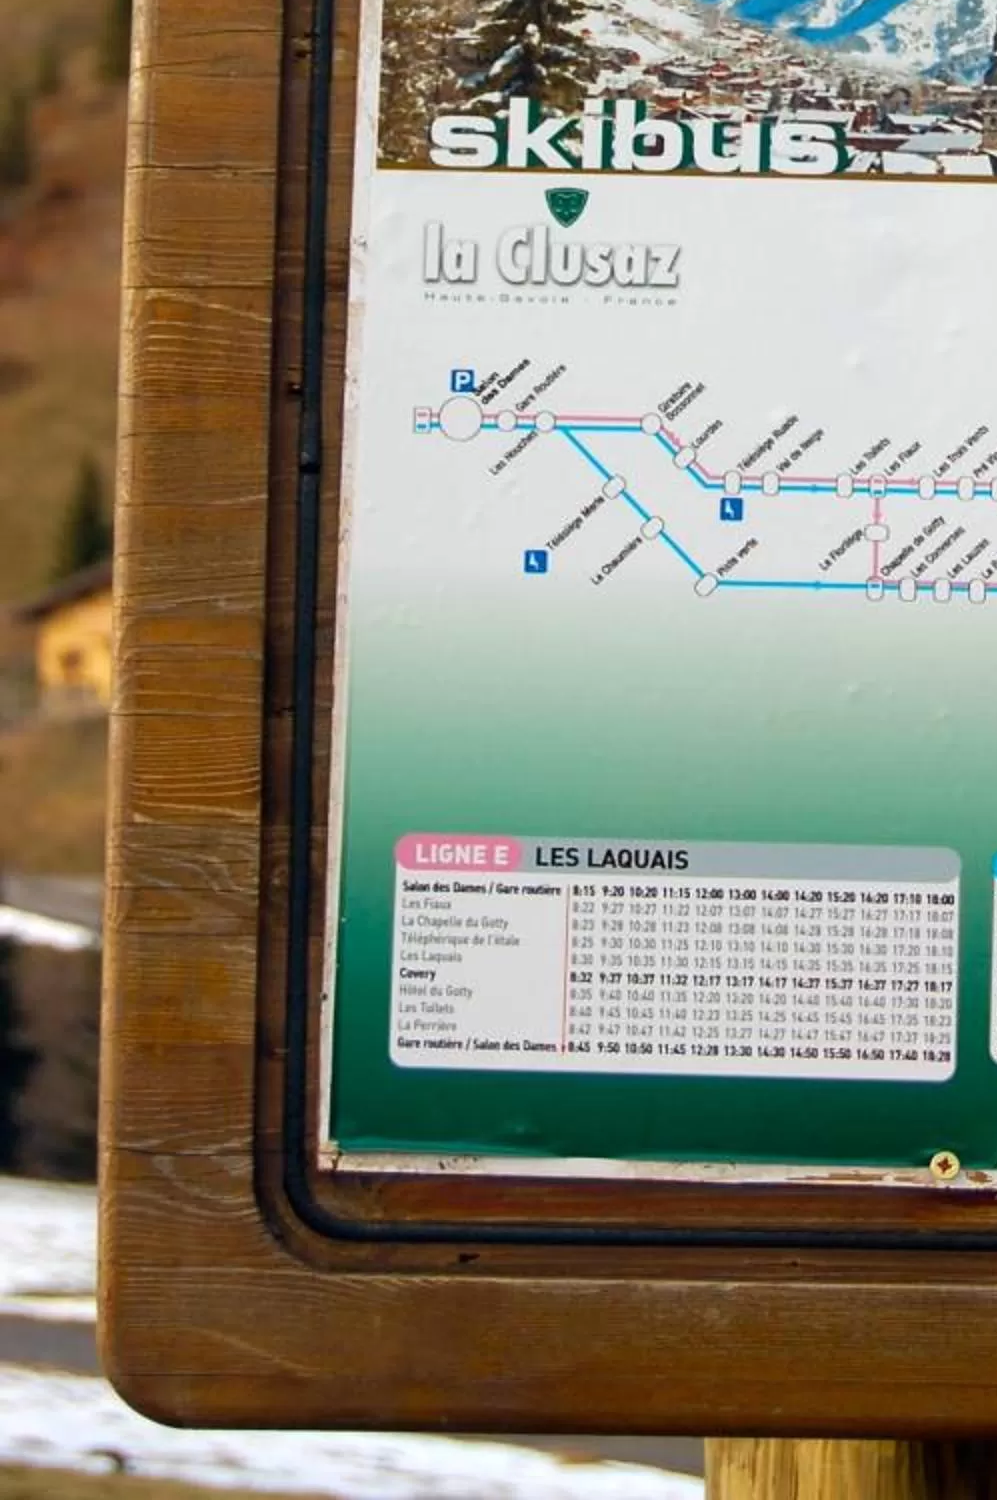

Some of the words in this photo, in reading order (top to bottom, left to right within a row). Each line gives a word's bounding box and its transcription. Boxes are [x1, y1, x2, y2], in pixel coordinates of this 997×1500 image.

[430, 97, 839, 175] skibus
[424, 221, 478, 283] la
[496, 224, 680, 287] Clusaz
[456, 372, 472, 390] P
[481, 389, 499, 404] des
[498, 359, 531, 388] Dames
[416, 844, 488, 864] LIGNE
[494, 846, 509, 865] E
[535, 846, 578, 867] LES
[588, 848, 689, 870] LAQUAIS
[403, 880, 429, 892] Salon
[432, 882, 450, 893] des
[453, 882, 486, 894] Dames
[496, 884, 519, 894] Gare
[402, 898, 420, 909] Les
[402, 916, 414, 926] La
[466, 917, 478, 927] du
[472, 934, 484, 945] de
[430, 986, 442, 996] du
[398, 1020, 410, 1030] La
[397, 1037, 421, 1048] Gare
[473, 1039, 500, 1049] Salon
[503, 1040, 520, 1050] des
[523, 1040, 556, 1051] Dames
